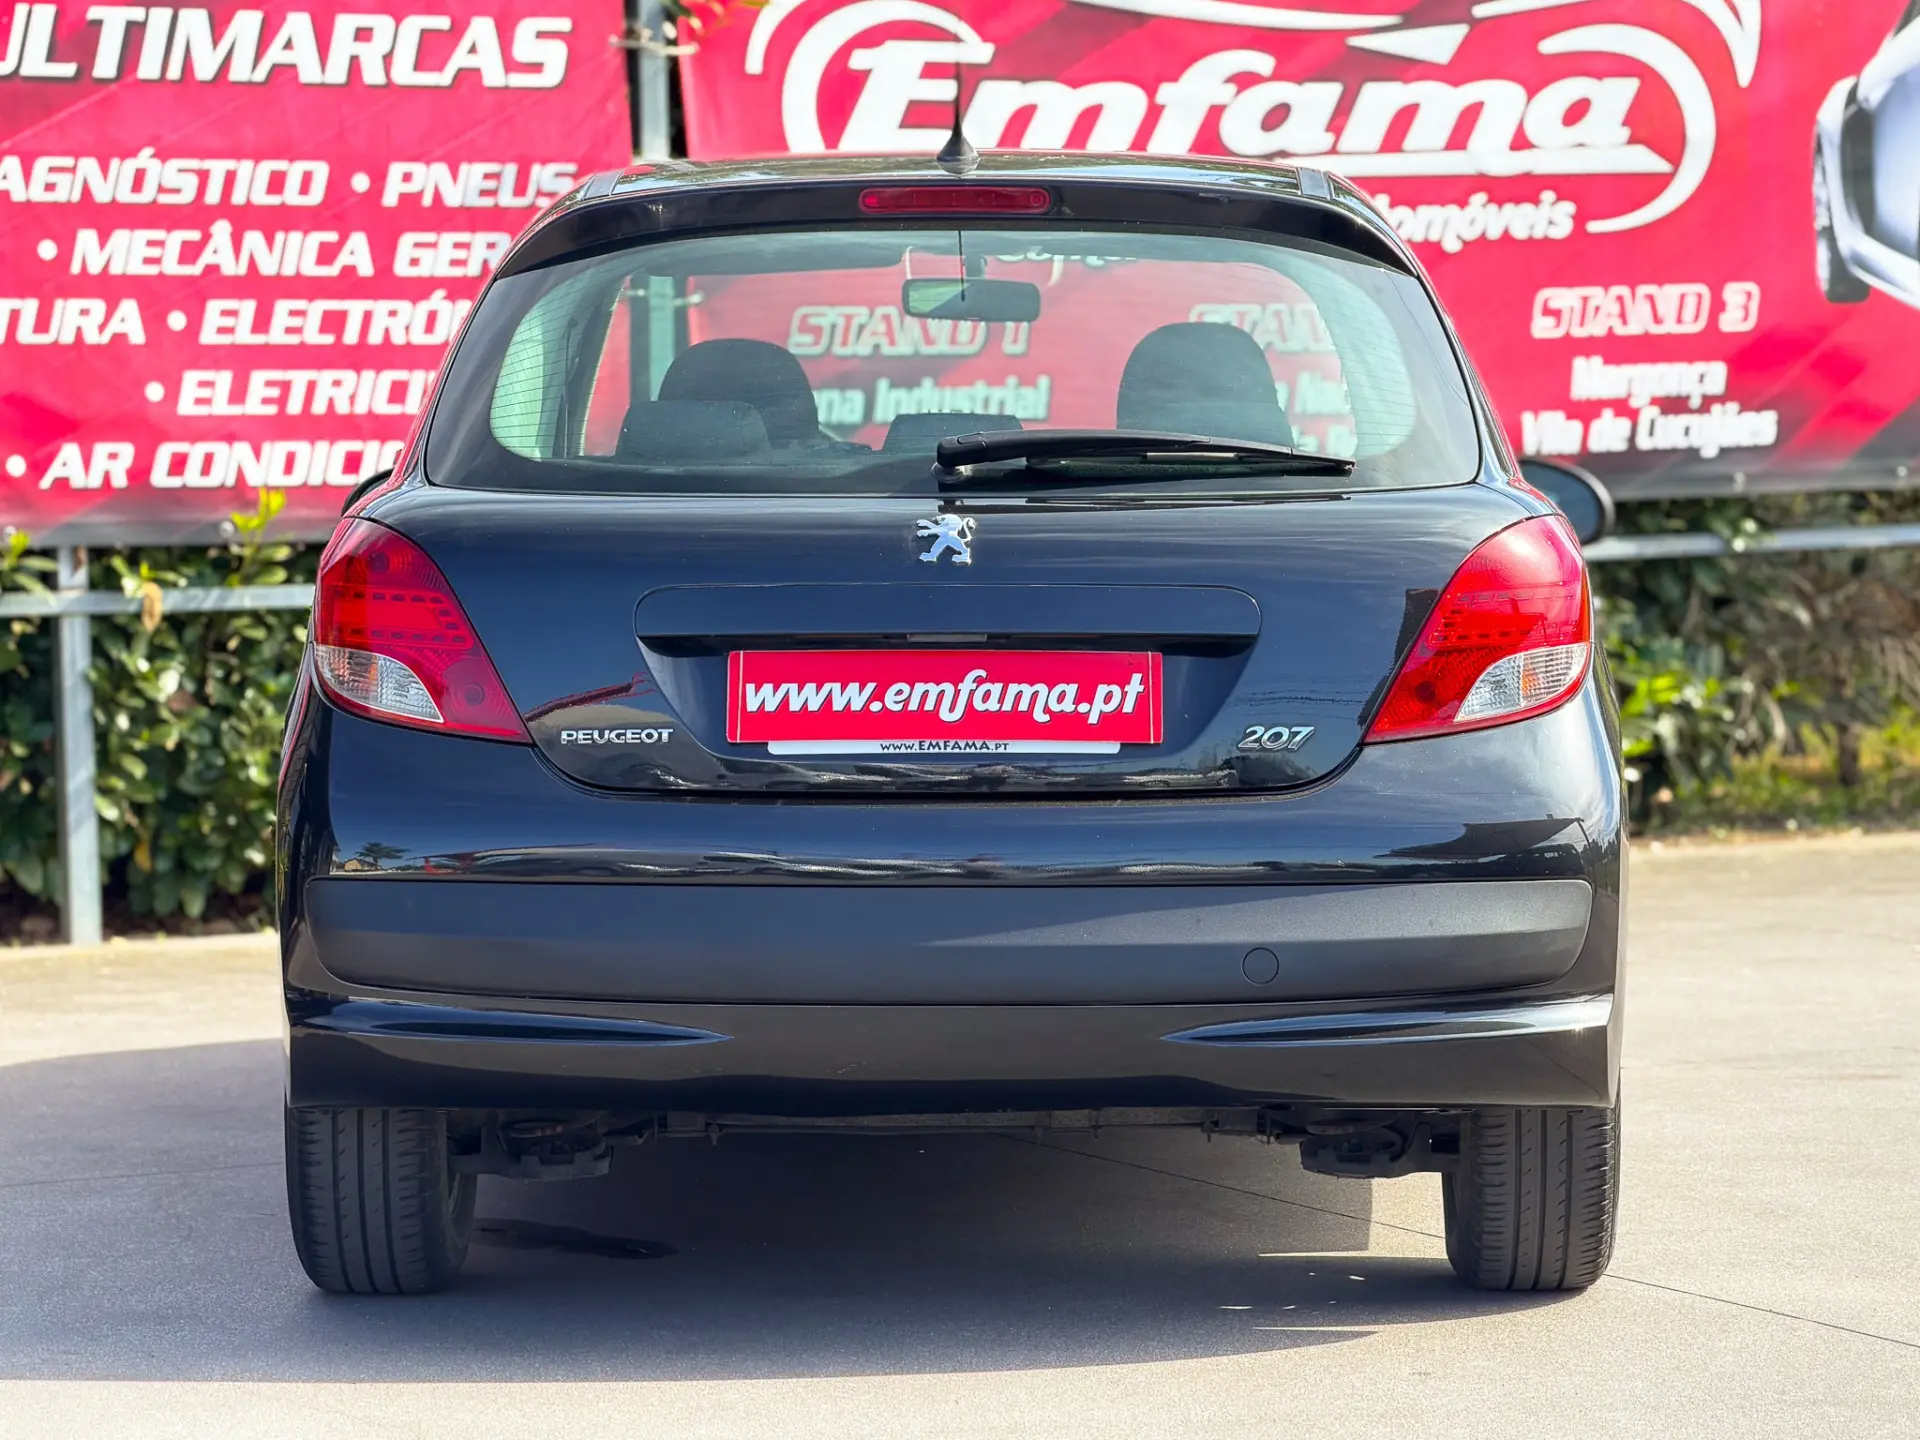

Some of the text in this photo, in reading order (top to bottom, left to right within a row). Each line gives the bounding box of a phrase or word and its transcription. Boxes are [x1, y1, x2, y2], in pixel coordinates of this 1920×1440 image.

[845, 40, 1644, 177] Emfama
[381, 161, 578, 208] PNEUS
[69, 218, 374, 277] MECÂNICA
[1530, 281, 1760, 339] STAND 3
[176, 370, 438, 416] ELETRICI
[1521, 409, 1584, 456] Vila
[1587, 407, 1632, 453] de
[39, 442, 135, 488] AR
[744, 669, 1145, 724] www.emfama.pt
[560, 728, 674, 744] PEUGEOT
[1237, 725, 1315, 751] 207
